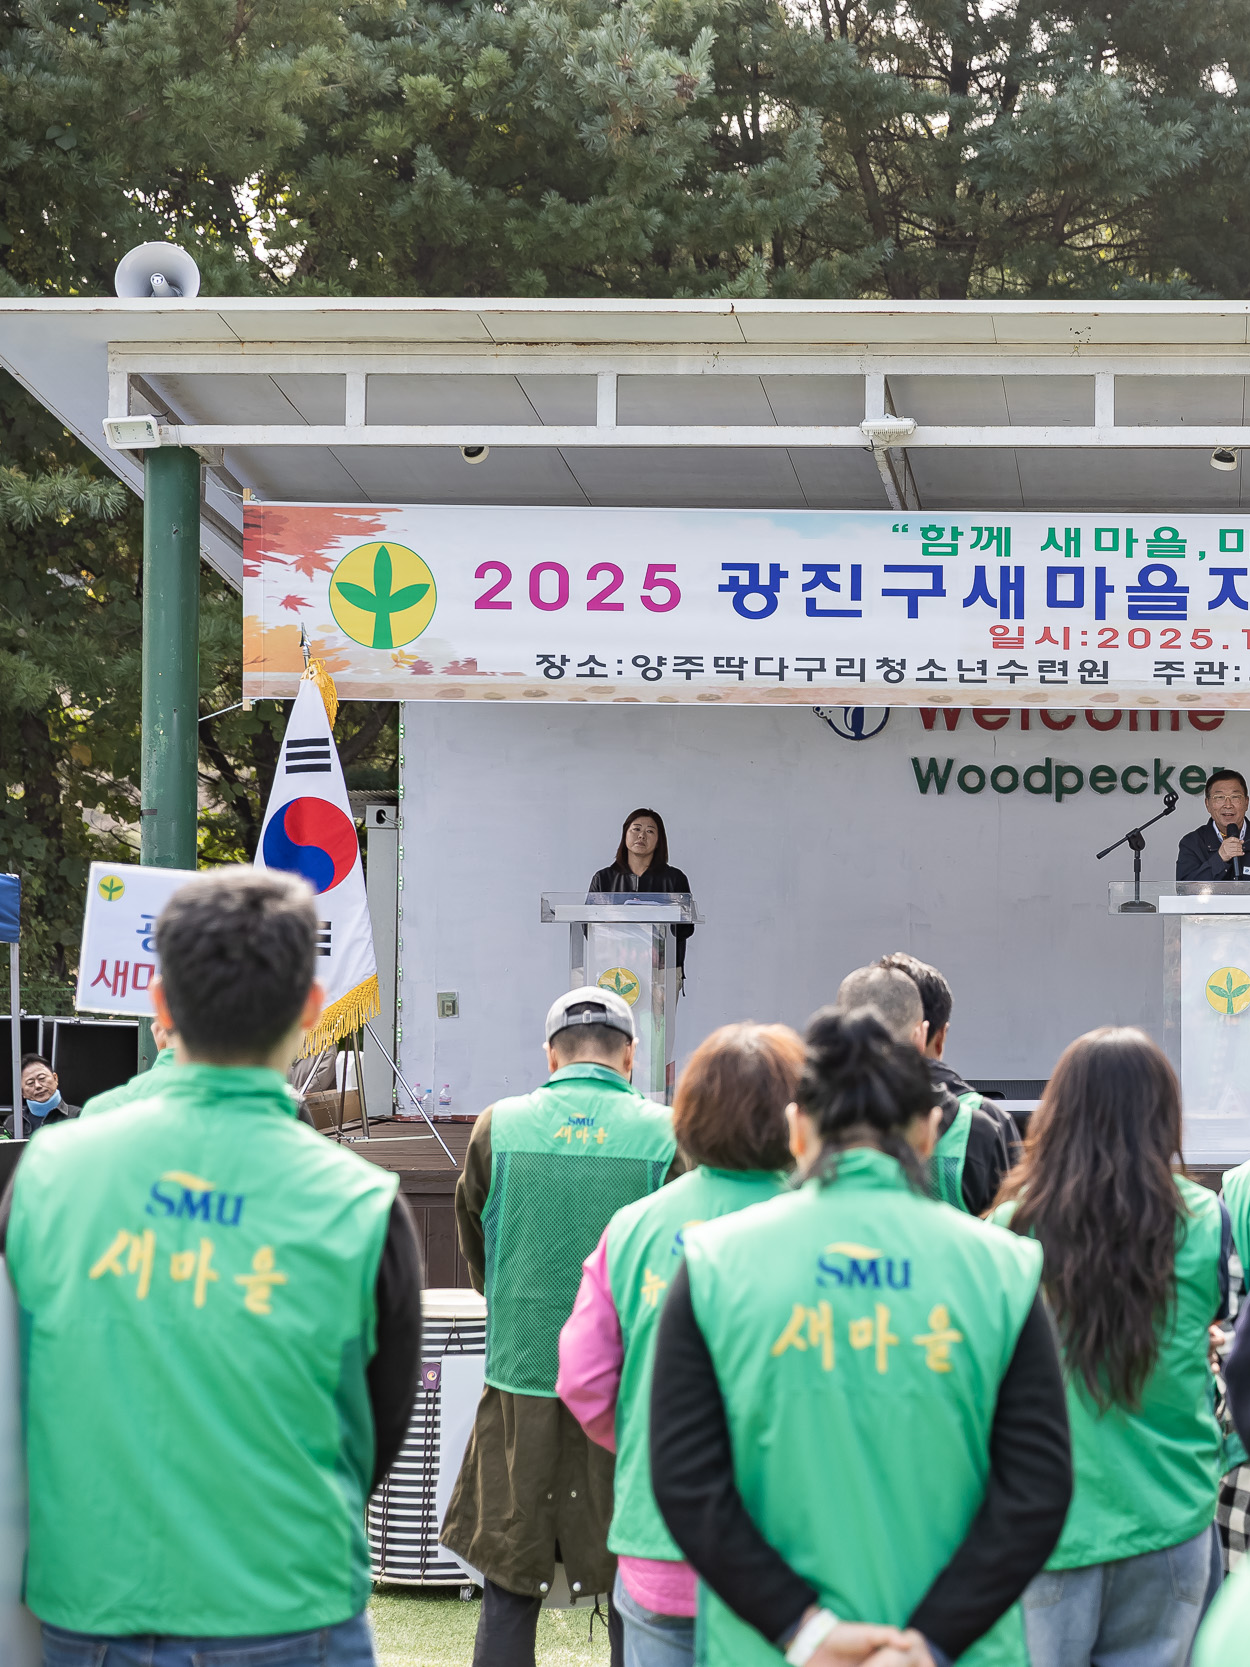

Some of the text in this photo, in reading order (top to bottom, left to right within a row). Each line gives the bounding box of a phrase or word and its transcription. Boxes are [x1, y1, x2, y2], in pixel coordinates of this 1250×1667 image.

[893, 524, 1011, 557] “함께
[475, 560, 681, 613] 2025
[536, 652, 1111, 685] 장소:양주딱다구리청소년수련원
[911, 757, 1225, 802] Woodpecke
[553, 1125, 609, 1145] 새마을
[567, 1115, 595, 1127] SMU
[144, 1179, 246, 1227] SMU
[88, 1227, 289, 1316] 새마을
[814, 1254, 913, 1291] SMU
[769, 1298, 964, 1375] 새마을
